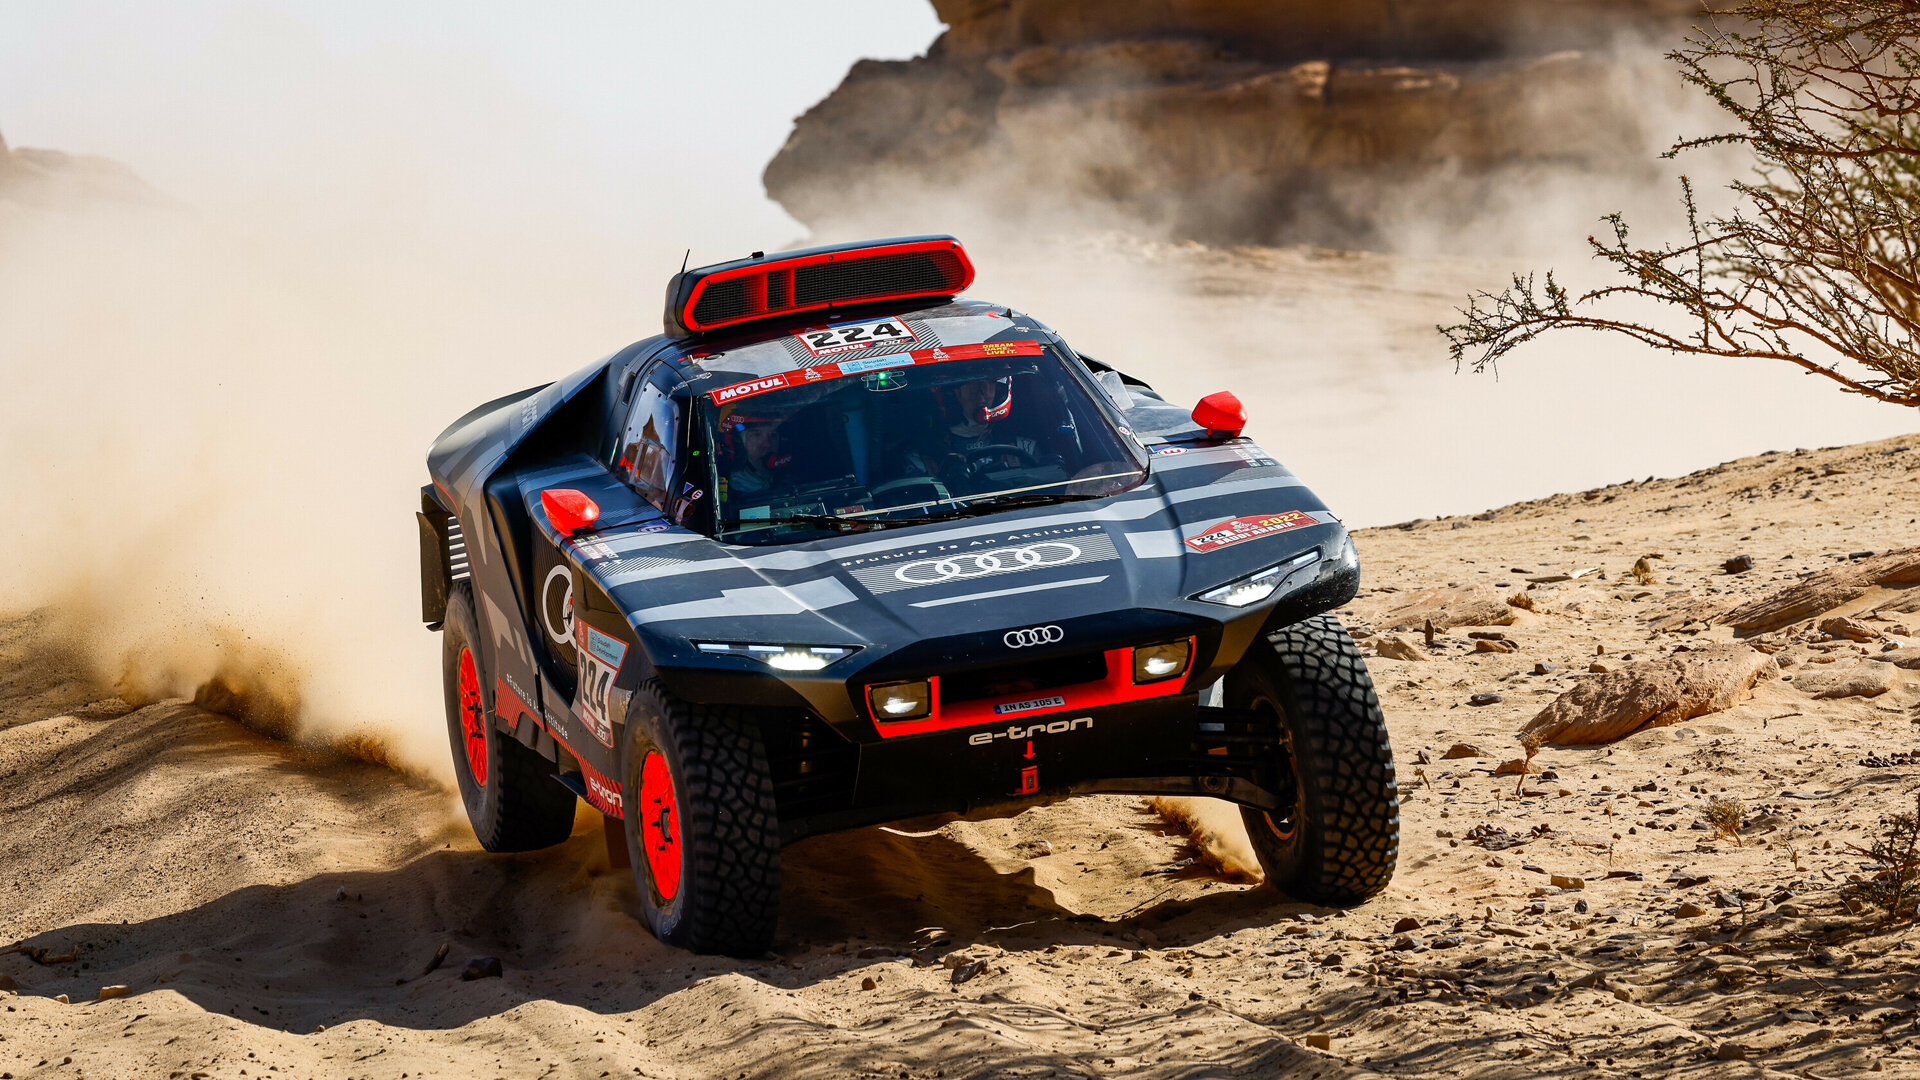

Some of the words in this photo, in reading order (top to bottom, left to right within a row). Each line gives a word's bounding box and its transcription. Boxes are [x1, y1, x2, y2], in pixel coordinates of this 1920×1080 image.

[806, 322, 903, 348] 224
[818, 343, 867, 355] MOTUL
[719, 378, 784, 401] MOTUL
[1258, 512, 1305, 527] 2022
[1196, 532, 1227, 544] 224
[1214, 531, 1250, 545] SAUDI
[1251, 522, 1297, 536] ARABIA
[840, 549, 928, 567] #Future
[969, 539, 996, 547] An
[1008, 525, 1102, 541] Attitude
[579, 651, 610, 722] 224
[1004, 703, 1017, 712] IN
[1019, 701, 1032, 710] AS
[1033, 698, 1052, 708] 105
[1053, 697, 1062, 705] E
[968, 717, 1094, 746] e-tron
[589, 776, 623, 808] e-tron
